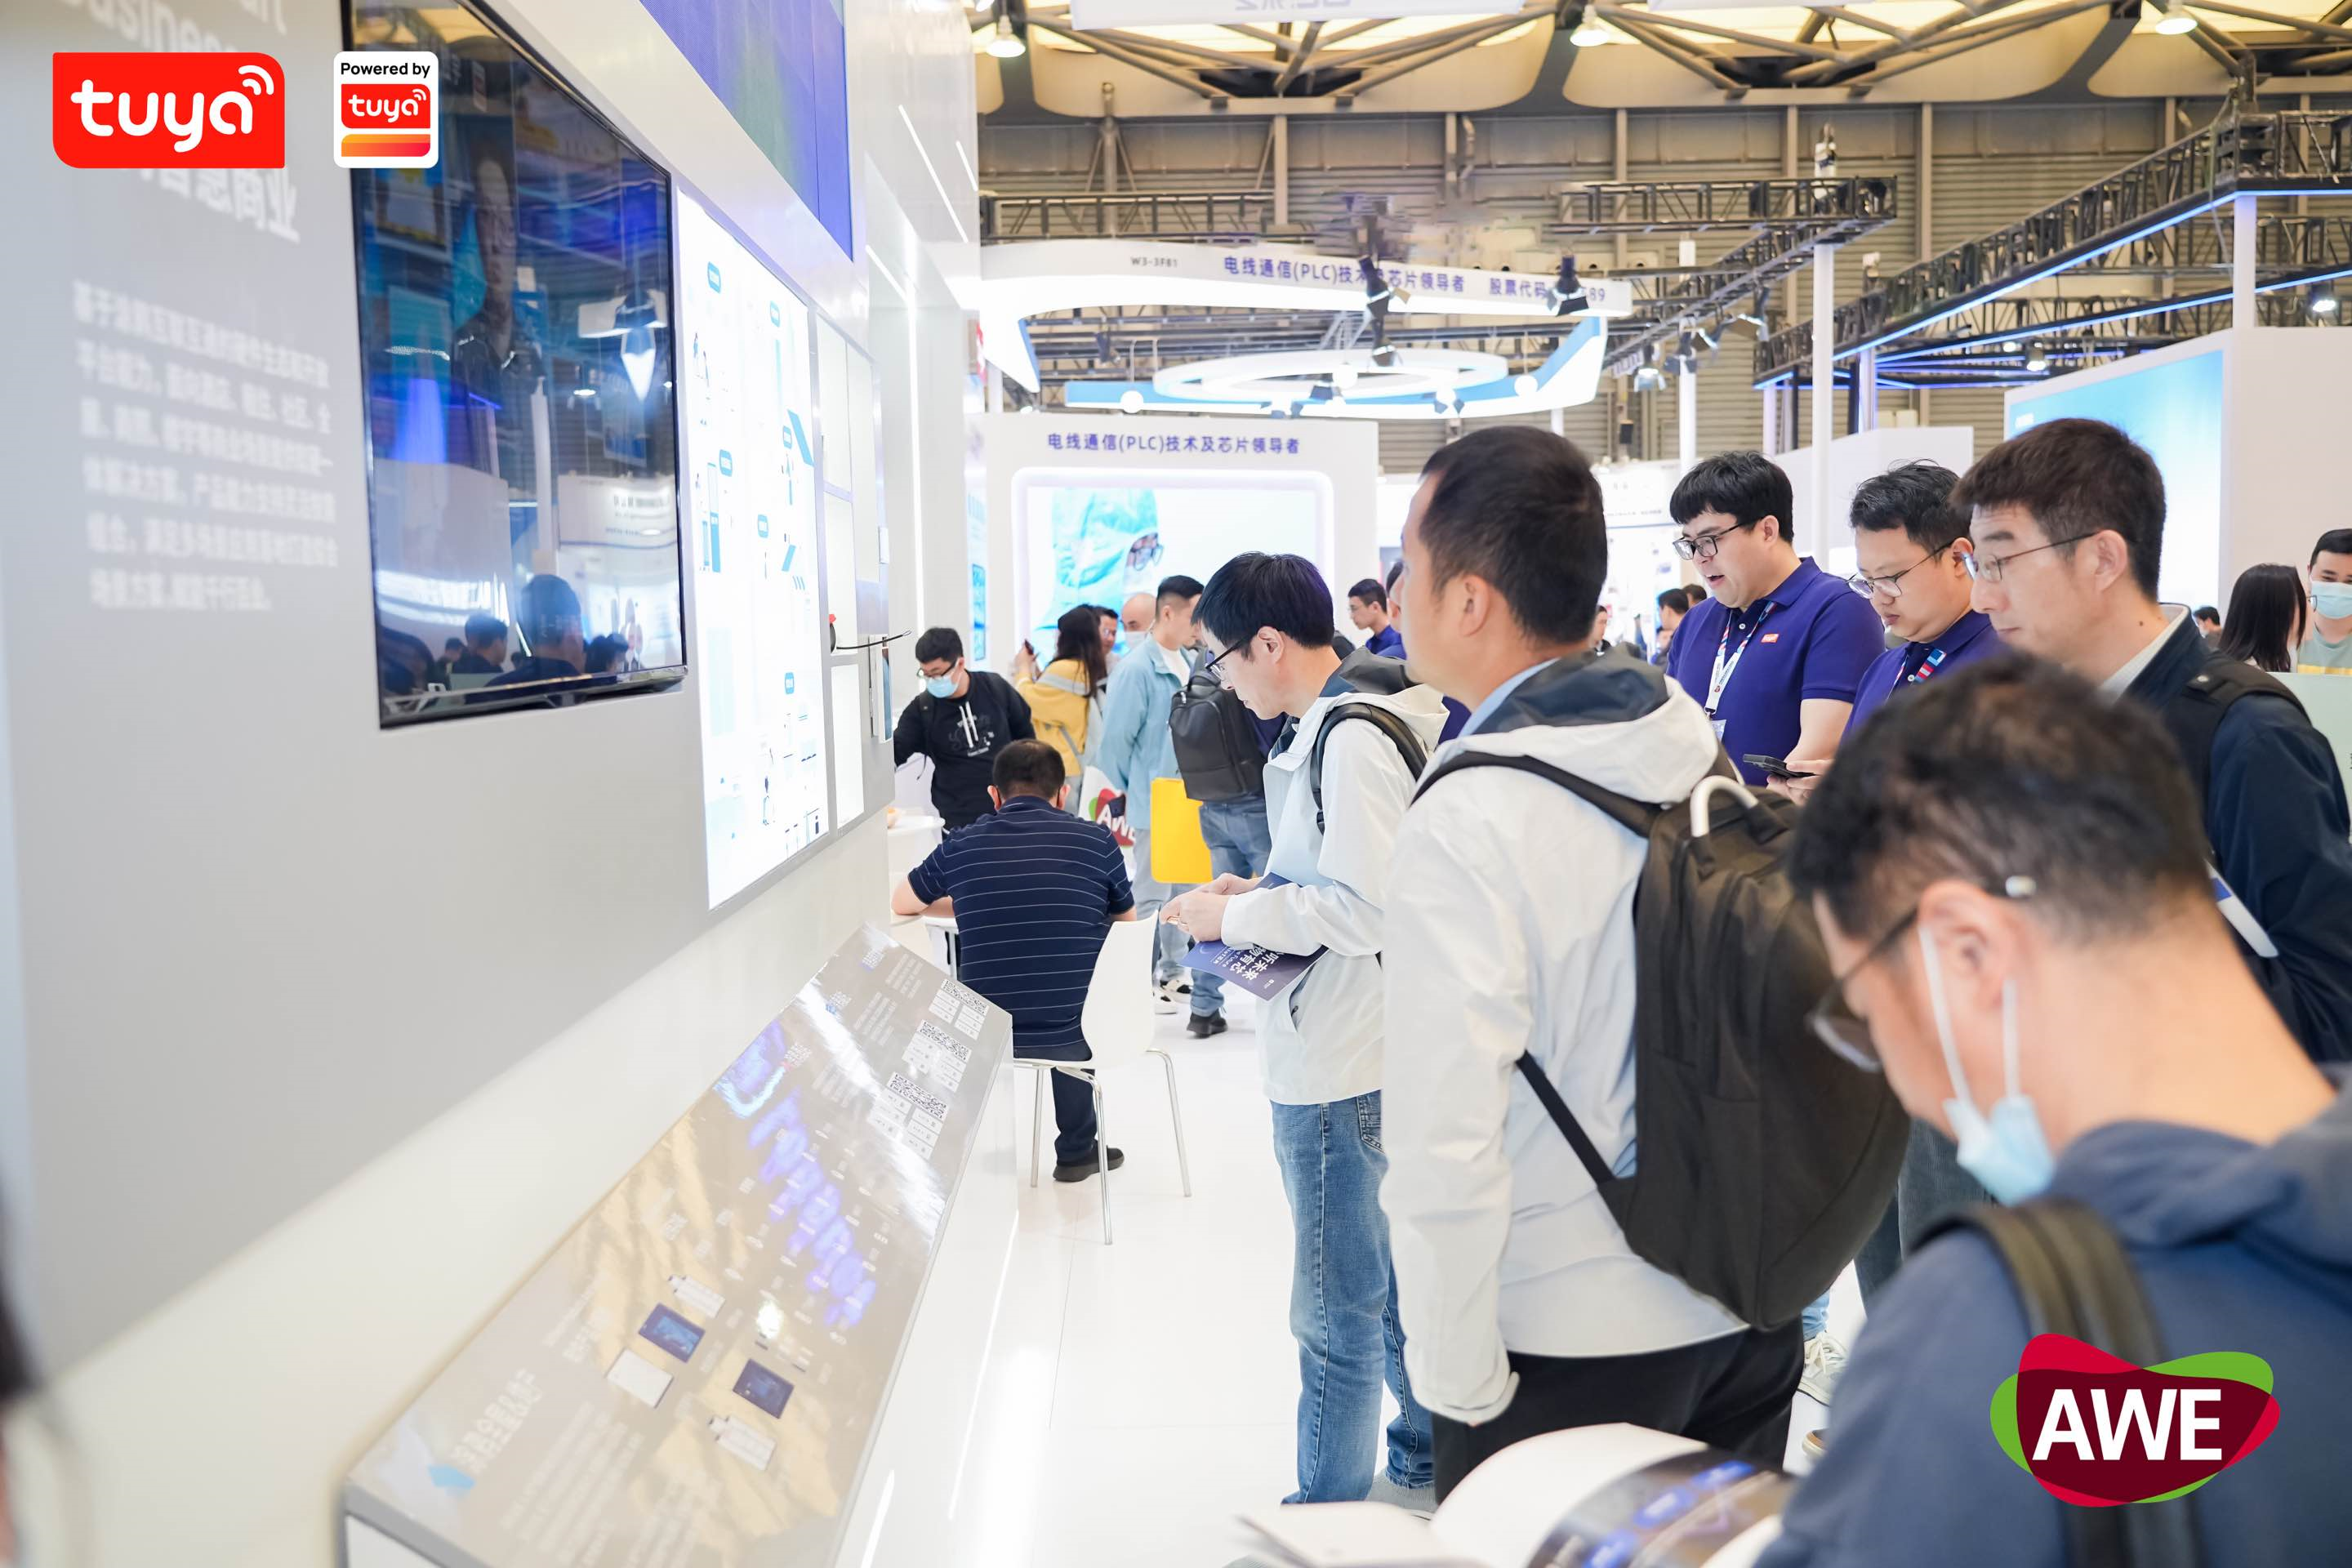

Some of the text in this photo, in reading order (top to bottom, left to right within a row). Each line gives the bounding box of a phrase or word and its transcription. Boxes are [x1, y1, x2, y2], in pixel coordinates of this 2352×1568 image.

[1048, 433, 1300, 455] 电线通信(PLC)技术及芯片领导者
